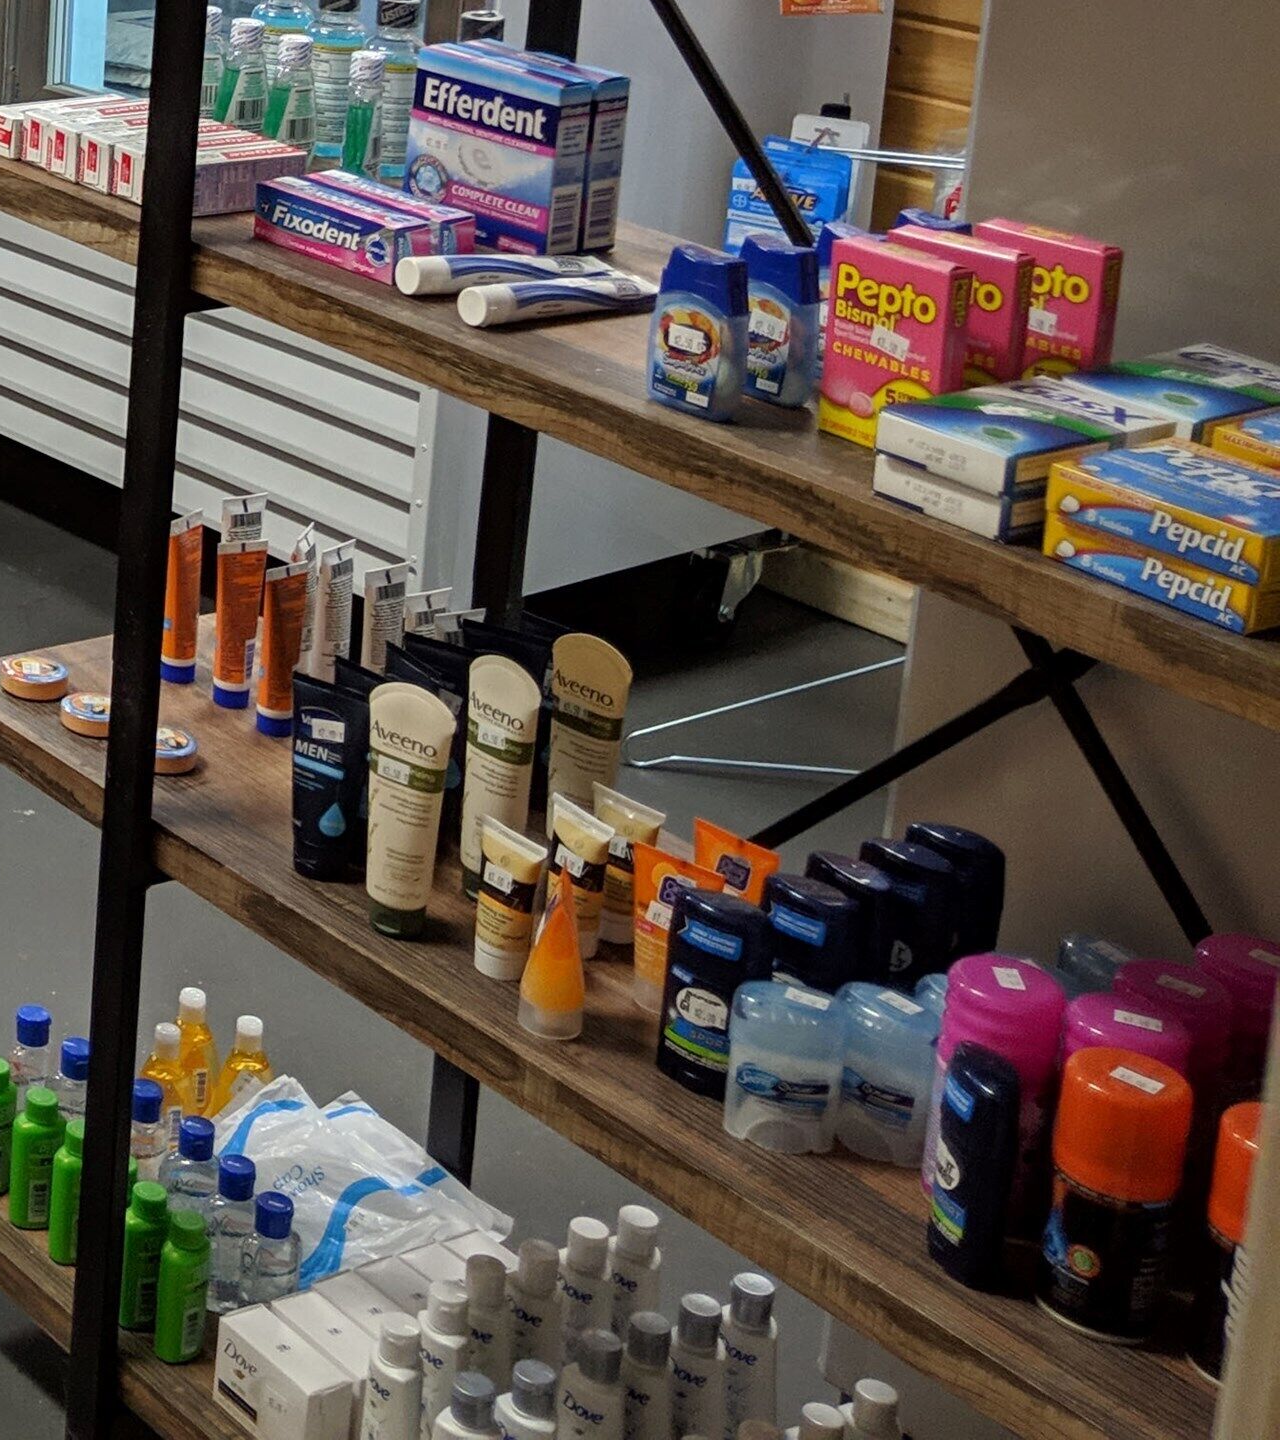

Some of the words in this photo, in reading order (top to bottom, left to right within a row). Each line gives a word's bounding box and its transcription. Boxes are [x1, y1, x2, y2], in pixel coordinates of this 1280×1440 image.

[423, 76, 547, 140] Efferdent
[452, 184, 503, 209] COMPLETE
[504, 198, 540, 219] CLEAN
[271, 204, 362, 253] Fixodent
[837, 263, 937, 324] Pepto
[832, 342, 932, 384] CHEWABLES
[1149, 510, 1246, 563] Pepcid
[1092, 562, 1127, 582] Tablets
[1140, 557, 1233, 611] Pepcid
[1230, 563, 1246, 576] AC
[1217, 612, 1234, 625] AC
[553, 668, 615, 708] Aveeno
[469, 690, 525, 731] Aveeno
[294, 738, 329, 762] MEN
[370, 719, 438, 758] Aveeno
[224, 1338, 258, 1376] Dove
[564, 1390, 604, 1425] Dove
